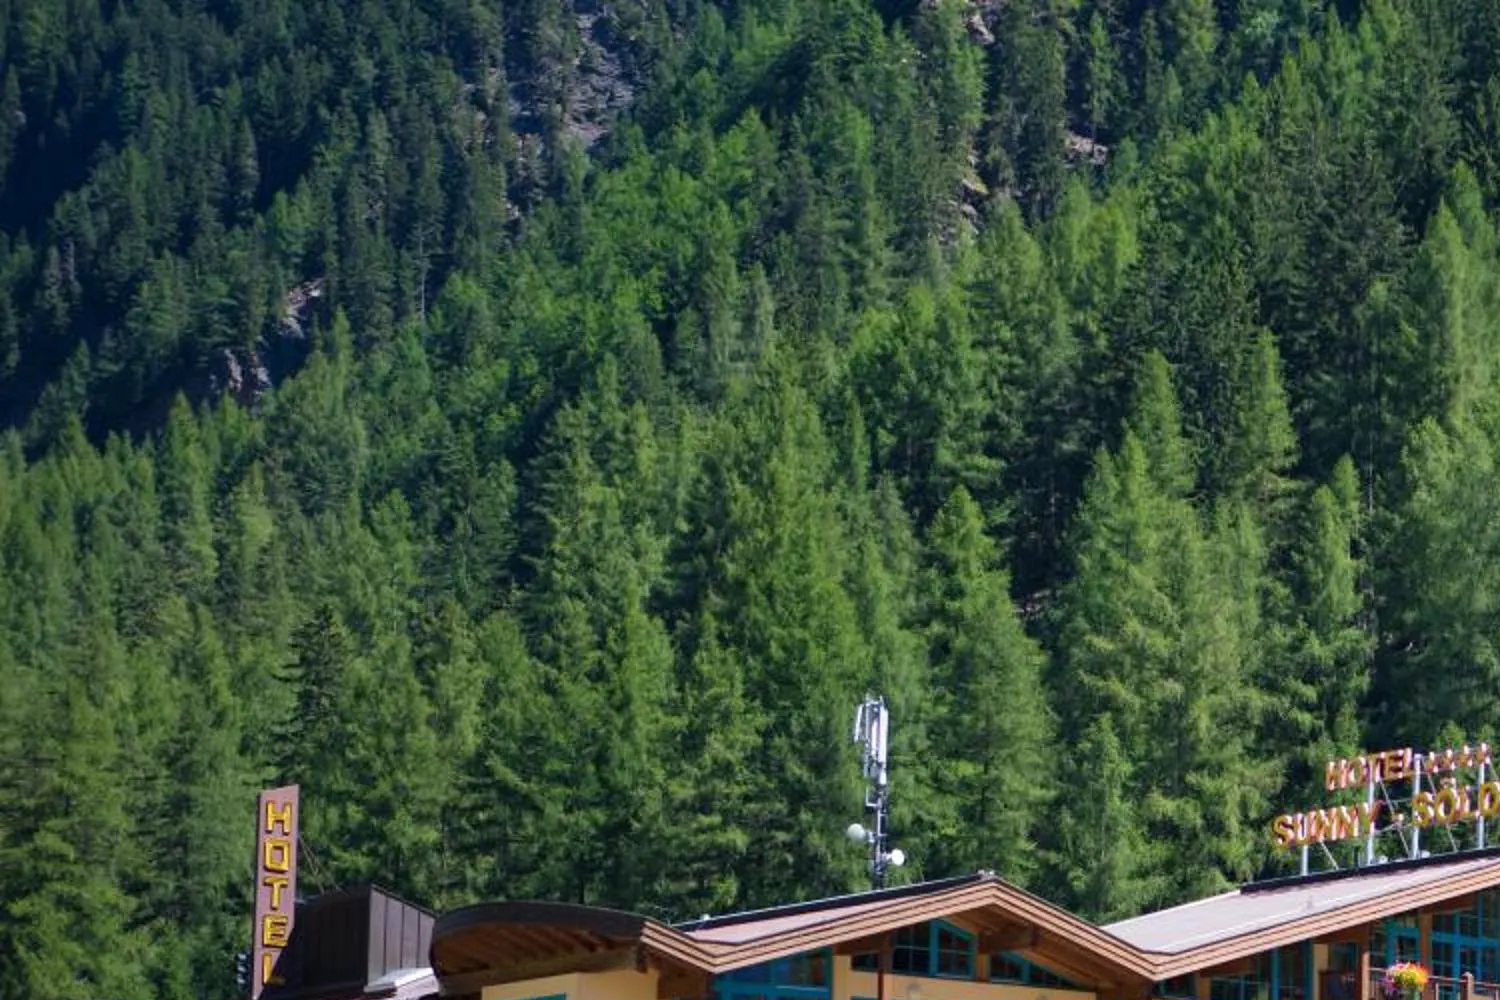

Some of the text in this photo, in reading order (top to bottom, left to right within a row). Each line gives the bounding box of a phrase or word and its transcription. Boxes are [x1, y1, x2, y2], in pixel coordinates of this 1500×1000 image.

[1325, 748, 1413, 791] HOTEL
[1272, 800, 1384, 848] SUNNY
[262, 800, 292, 985] HOTEL
